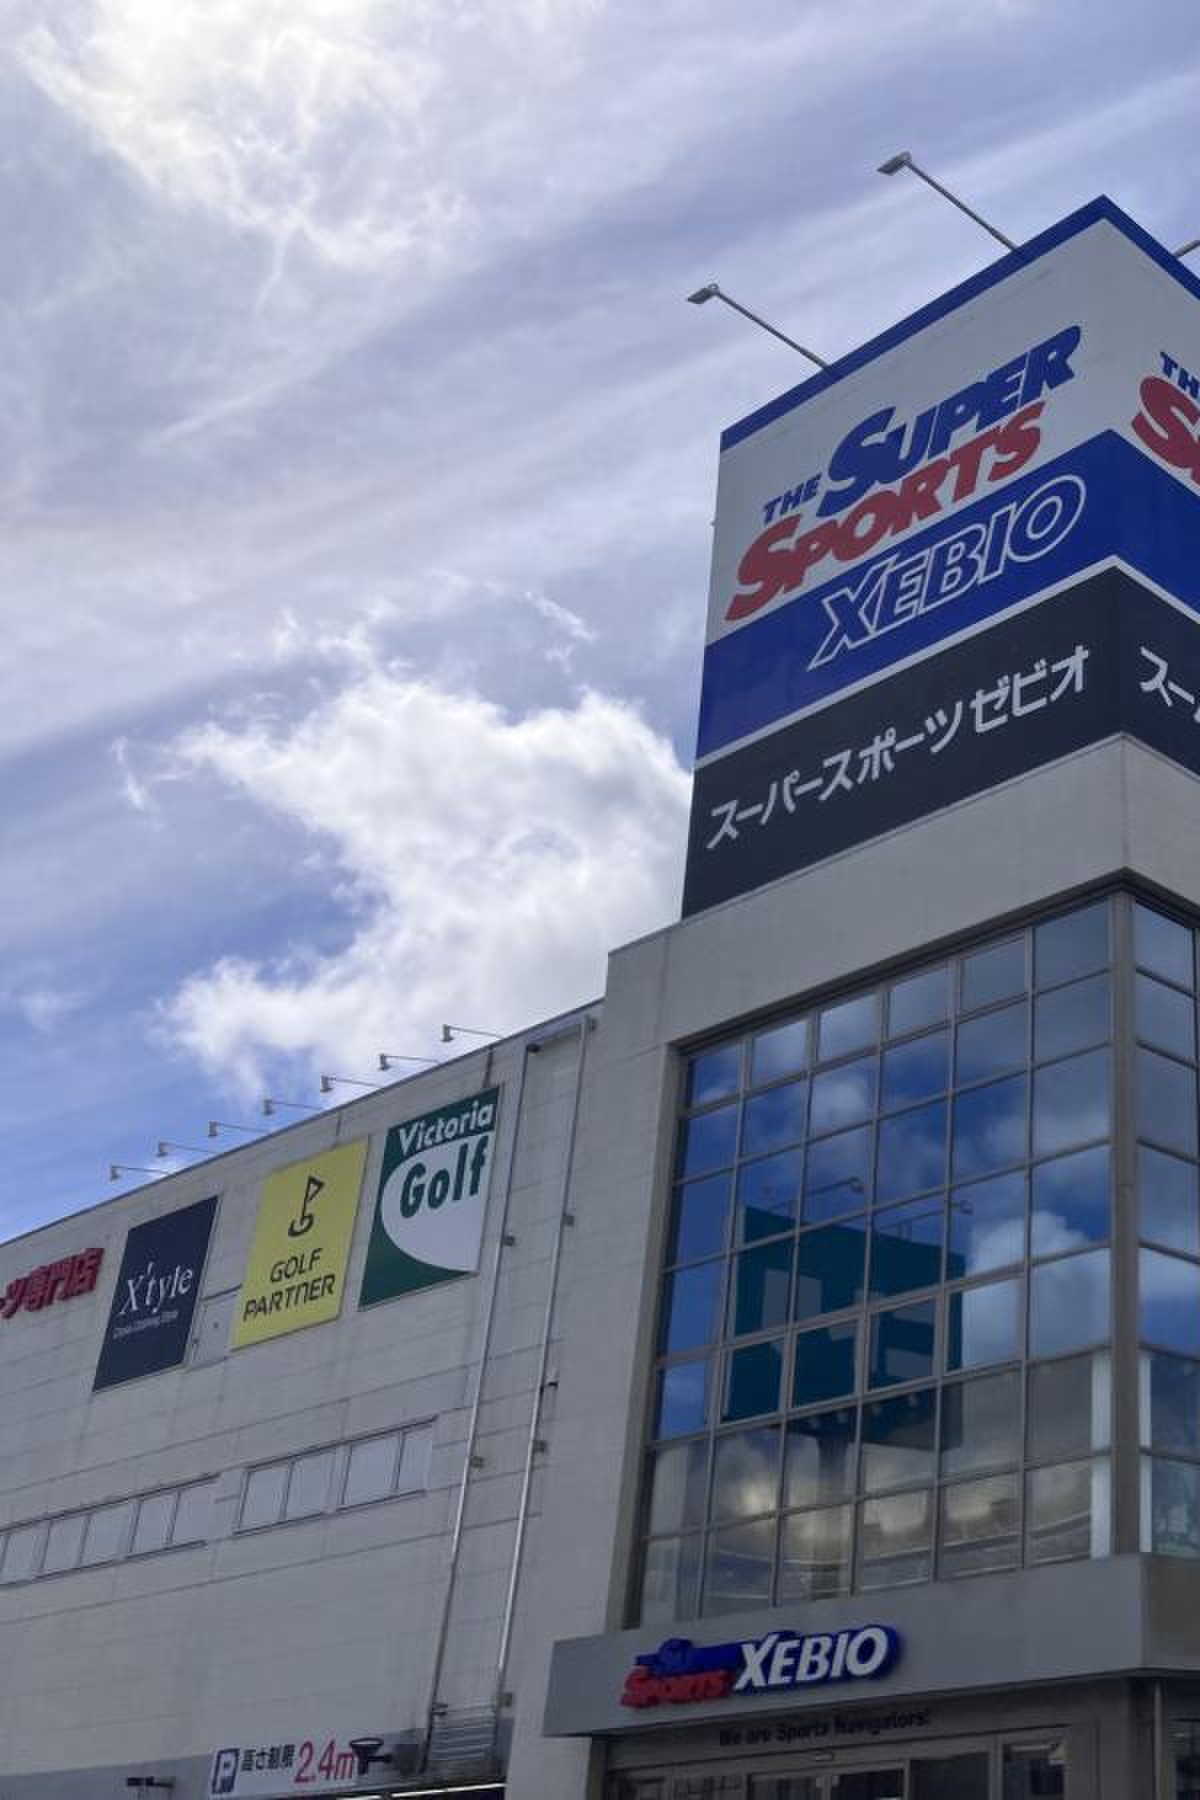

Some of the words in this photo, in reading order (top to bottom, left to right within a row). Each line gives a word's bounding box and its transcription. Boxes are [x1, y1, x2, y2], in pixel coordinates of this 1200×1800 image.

[763, 474, 822, 523] THE
[816, 325, 1081, 517] SUPER
[725, 401, 1045, 621] SPORTS
[806, 474, 1087, 672] XEBIO
[707, 644, 1089, 849] スーパースポーツゼビオ
[400, 1100, 496, 1157] Victoria
[400, 1136, 488, 1218] Golf
[0, 1248, 104, 1319] ツ専門店
[242, 1274, 335, 1322] PARTNER
[270, 1248, 322, 1283] GOLF
[734, 1627, 888, 1692] XEBIO
[294, 1740, 353, 1783] 2.4m
